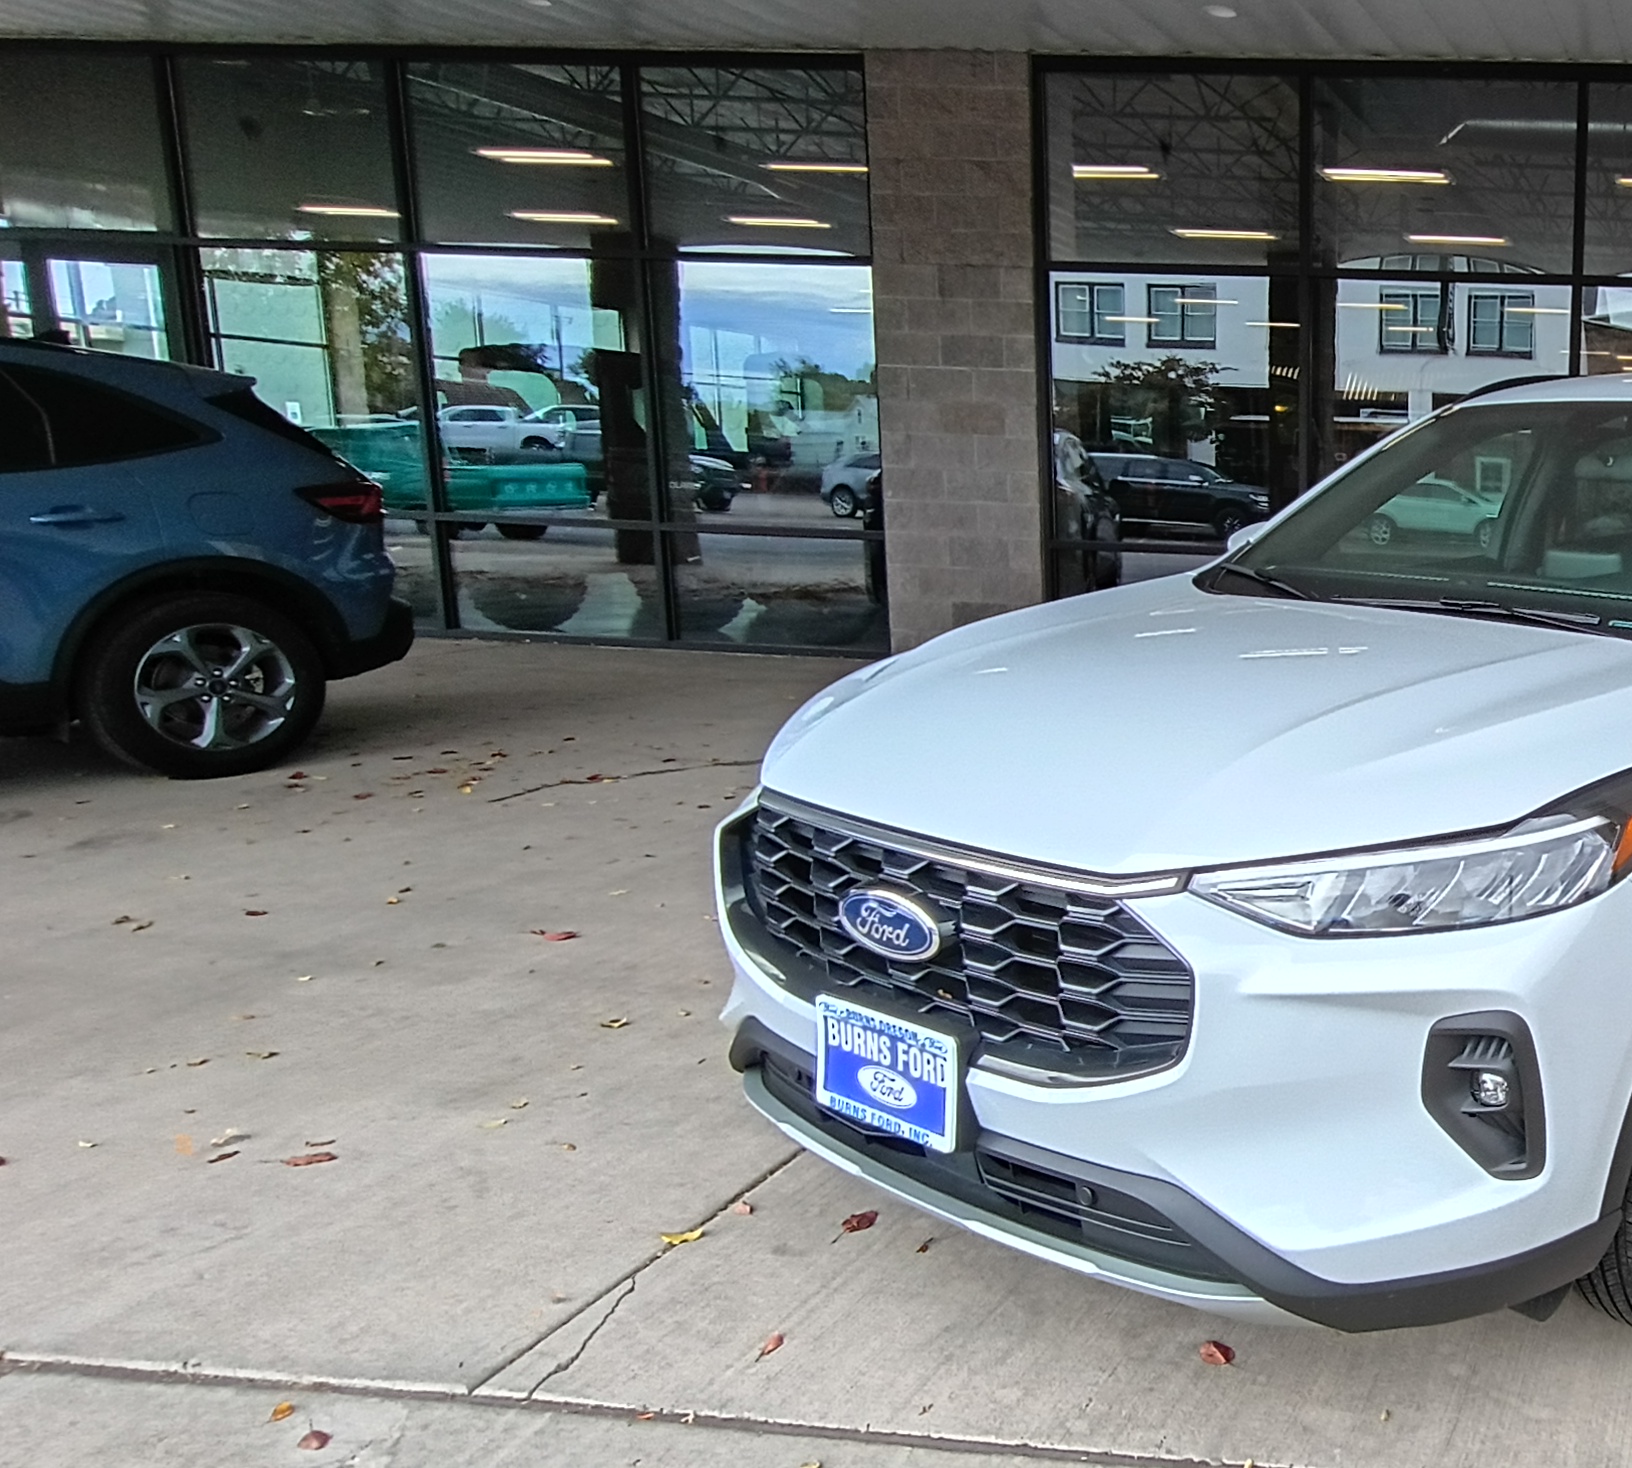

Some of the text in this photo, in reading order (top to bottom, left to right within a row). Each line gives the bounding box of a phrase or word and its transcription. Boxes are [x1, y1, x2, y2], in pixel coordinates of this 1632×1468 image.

[856, 900, 910, 947] Ford
[827, 1017, 947, 1088] BURNS FORD
[869, 1070, 905, 1102] Ford
[829, 1095, 933, 1147] BURNS FORD, INC.
